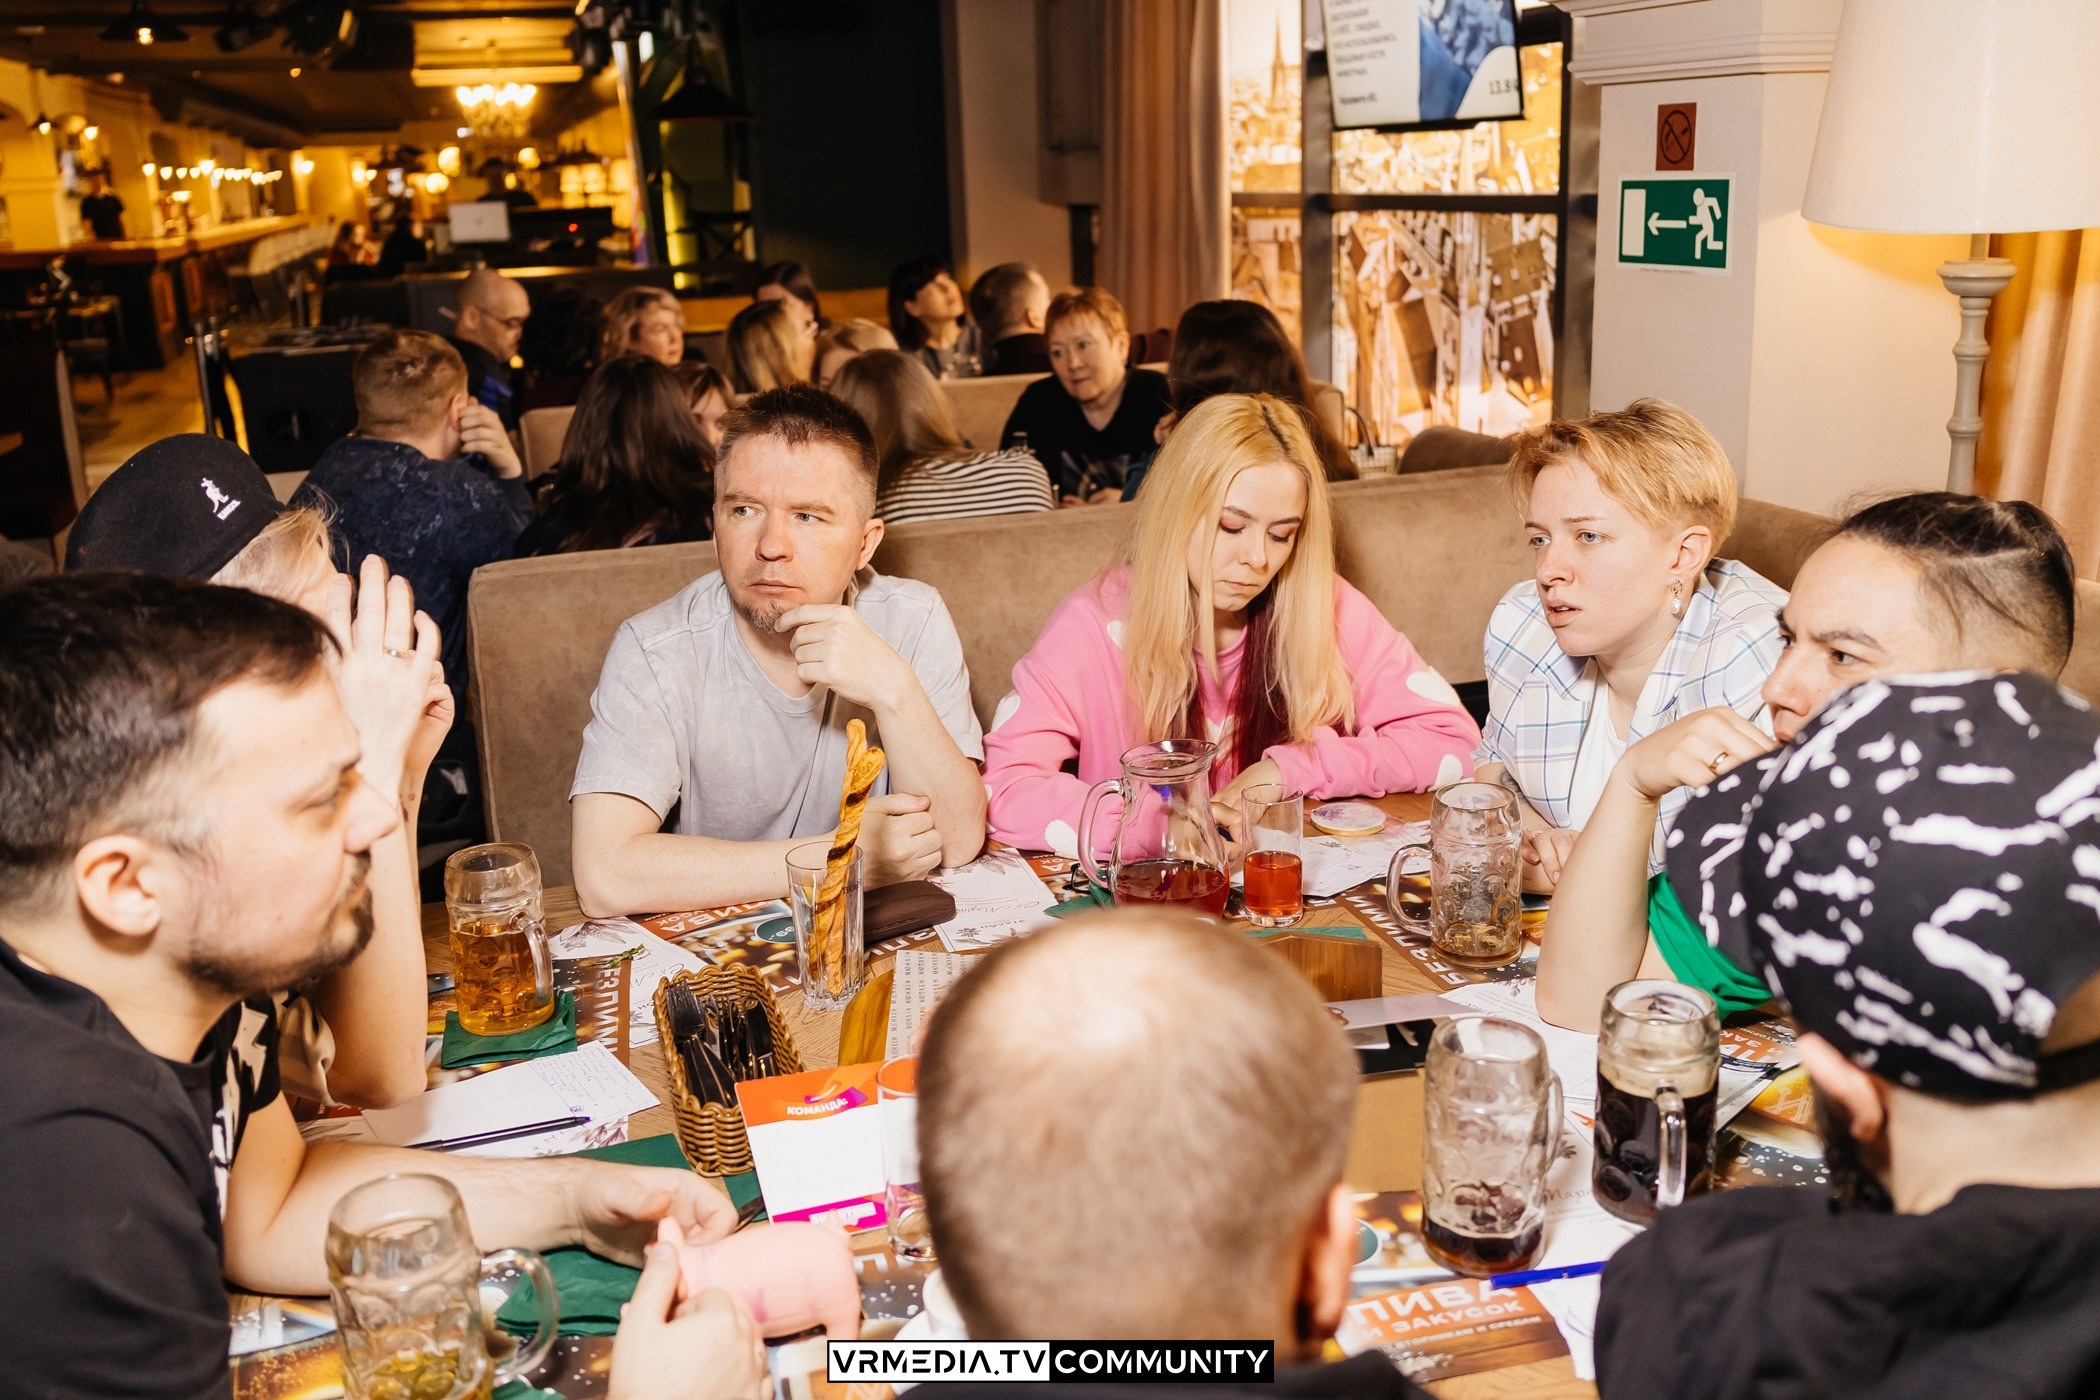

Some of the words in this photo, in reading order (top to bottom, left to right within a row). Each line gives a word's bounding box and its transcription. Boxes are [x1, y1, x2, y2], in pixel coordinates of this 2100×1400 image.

[1340, 888, 1470, 985] БЕЗЛИМИ
[786, 1098, 849, 1116] КОМАНДА:
[1347, 1281, 1518, 1325] ПИВА
[1390, 1300, 1525, 1334] ЗАКУСОК
